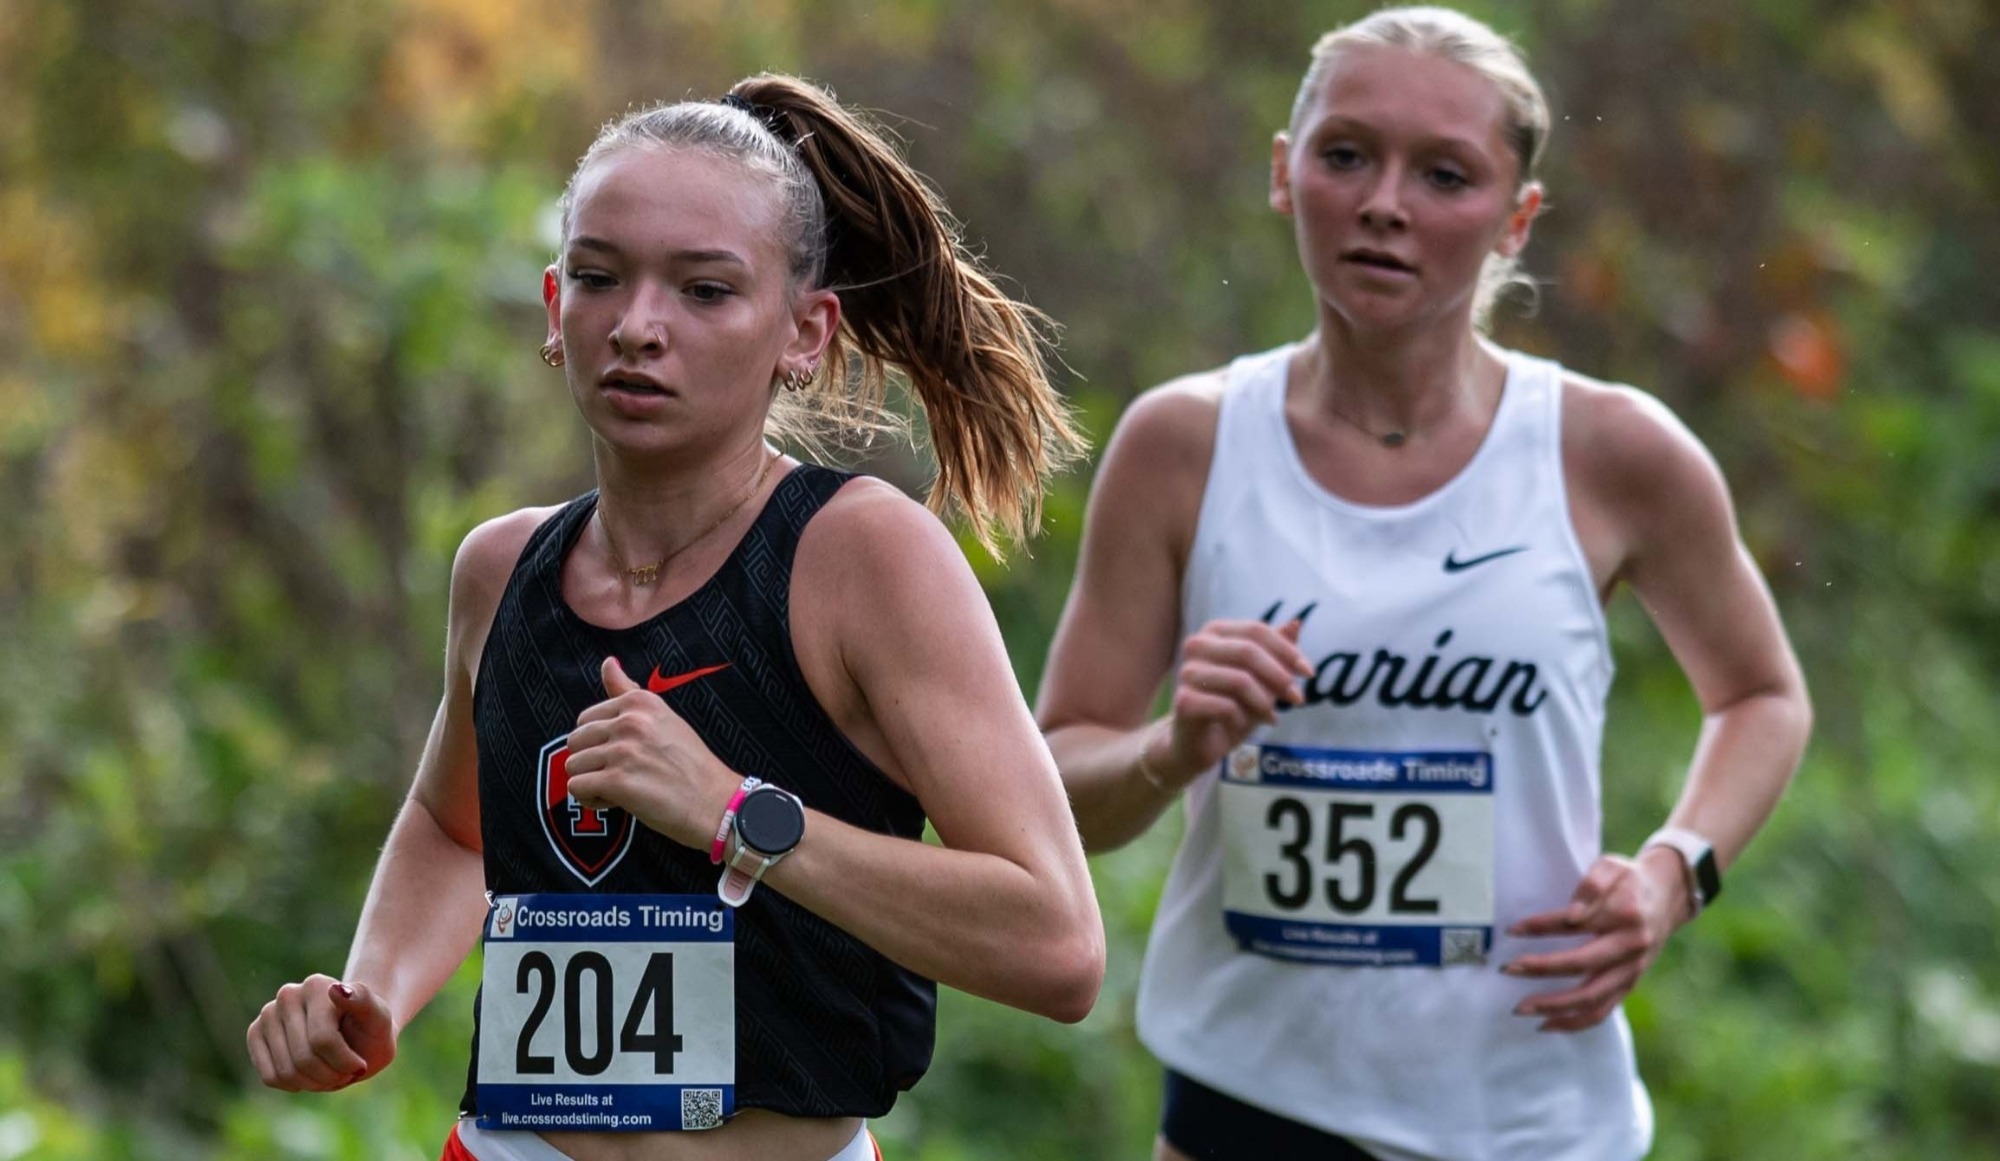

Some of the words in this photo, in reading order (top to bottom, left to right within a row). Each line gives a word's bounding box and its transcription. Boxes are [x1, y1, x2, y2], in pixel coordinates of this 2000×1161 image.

[1260, 600, 1547, 716] arian
[1262, 755, 1397, 782] Crossroads
[1405, 758, 1487, 787] Timing
[1264, 797, 1441, 916] 352
[517, 905, 631, 927] Crossroads
[638, 905, 724, 932] Timing
[516, 950, 683, 1076] 204
[531, 1093, 553, 1106] Live
[555, 1093, 599, 1106] Results
[601, 1093, 613, 1106] at
[501, 1112, 652, 1128] live.crossroadstiming.com
